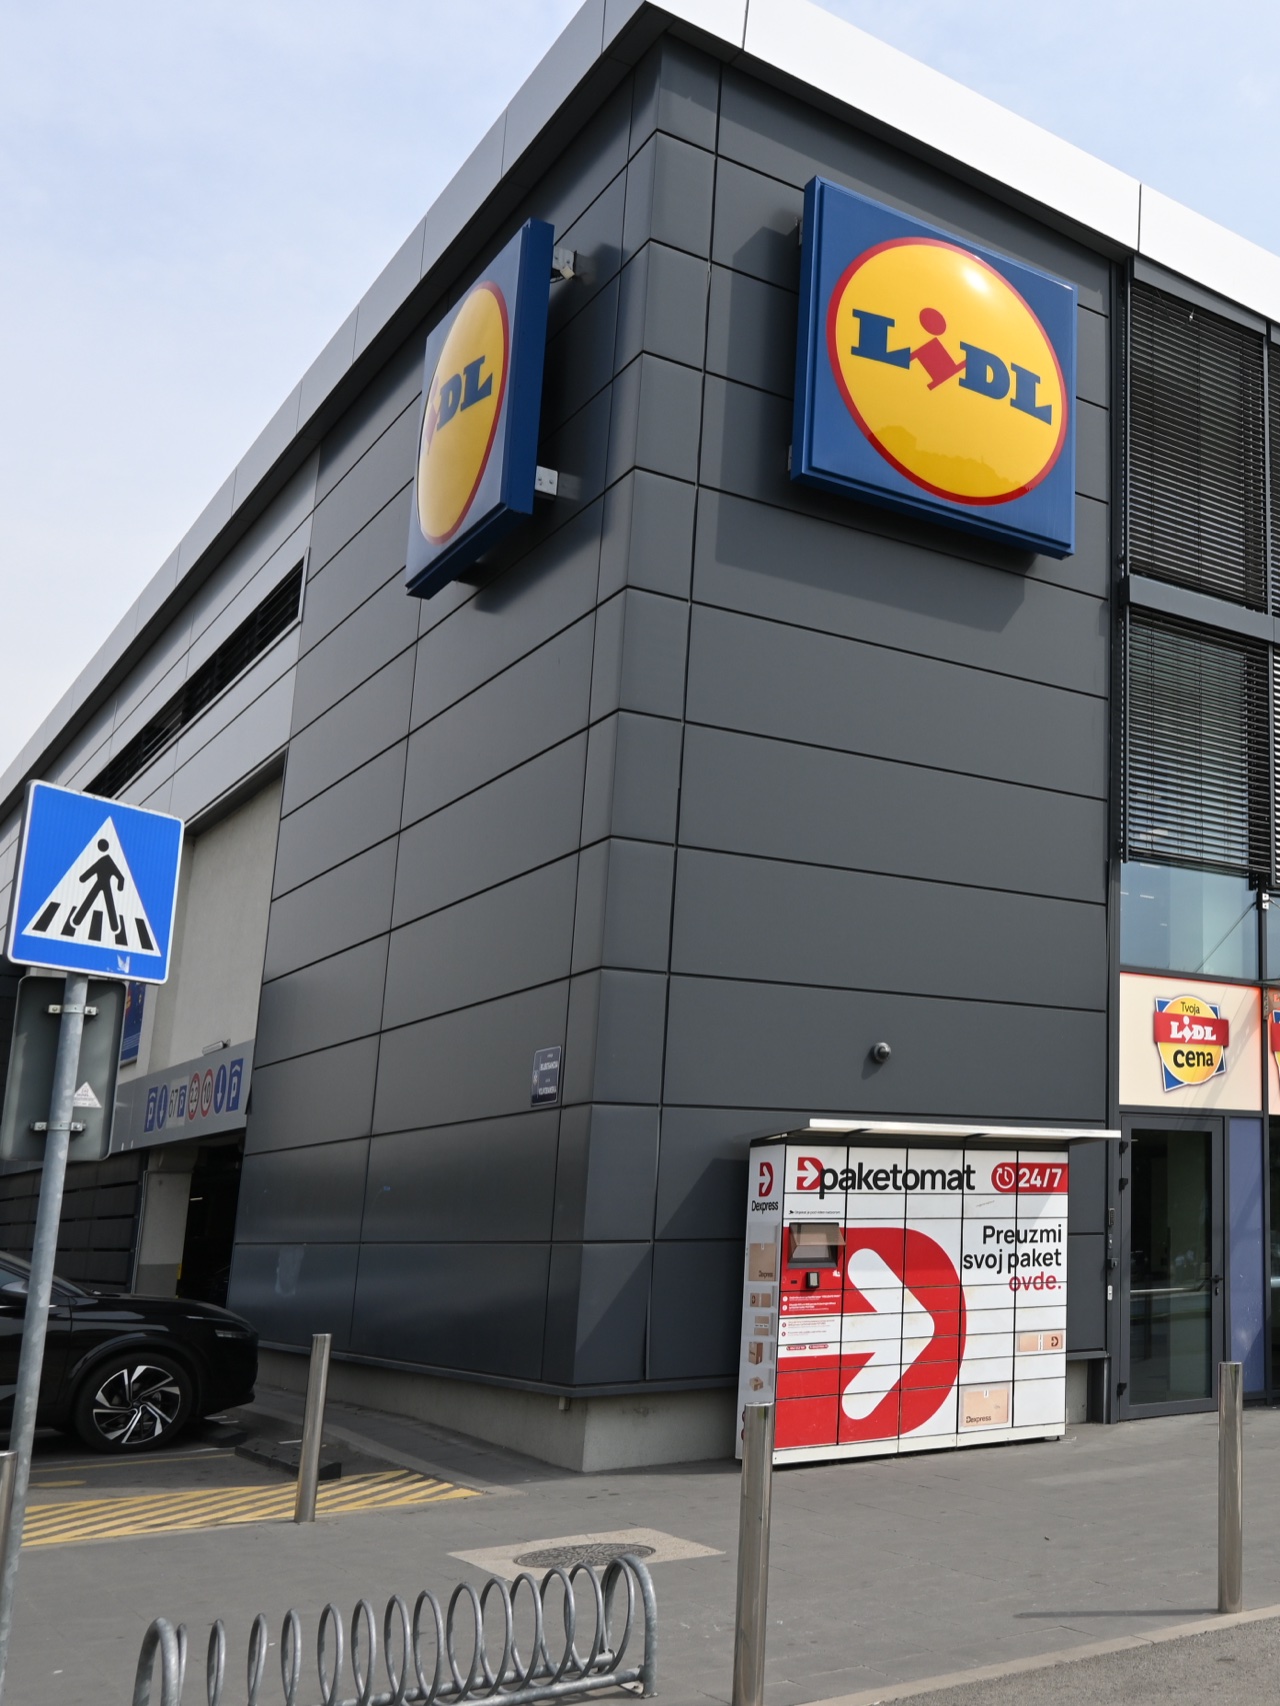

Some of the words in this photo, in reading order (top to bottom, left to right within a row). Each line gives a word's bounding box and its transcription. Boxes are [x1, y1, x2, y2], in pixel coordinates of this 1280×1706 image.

[1181, 1001, 1200, 1015] Tvoja
[1173, 1049, 1214, 1068] cena
[1018, 1167, 1062, 1188] 24/7
[751, 1200, 779, 1214] Dexpress
[982, 1224, 1062, 1244] Preuzmi
[963, 1248, 1003, 1274] svoj
[1007, 1248, 1062, 1274] paket
[1008, 1271, 1062, 1292] ovde.
[966, 1415, 992, 1424] Dexpress
